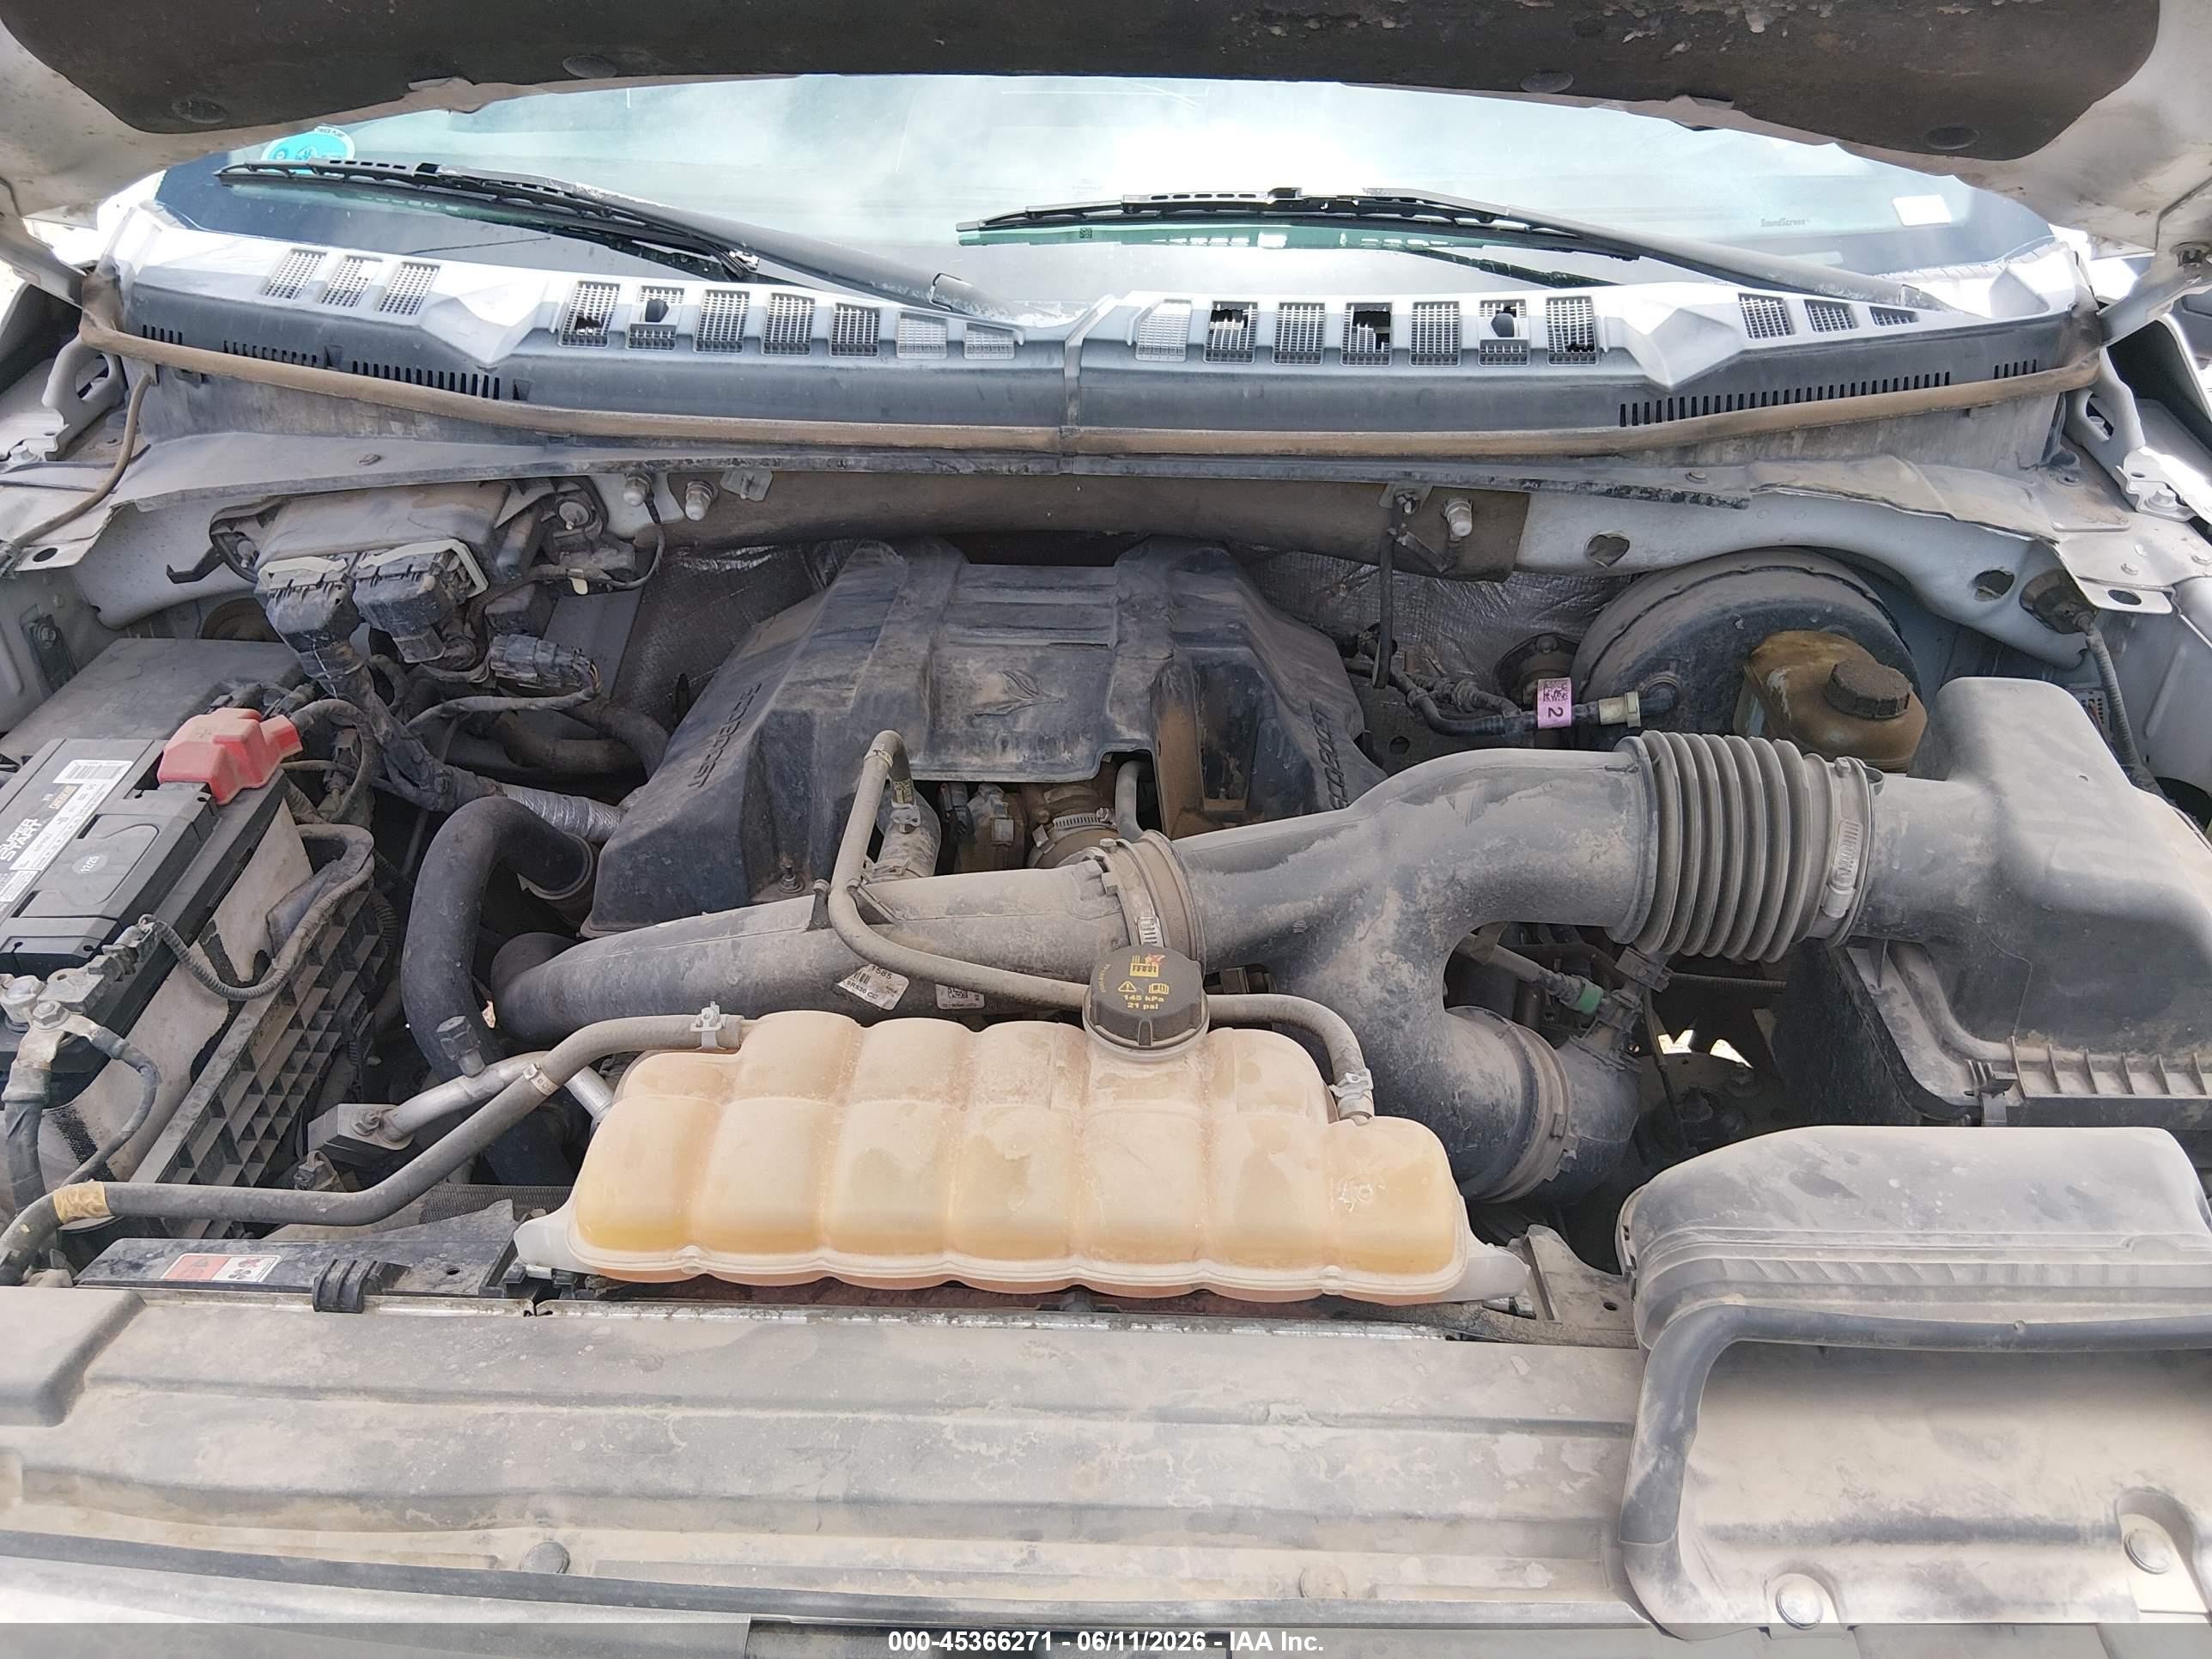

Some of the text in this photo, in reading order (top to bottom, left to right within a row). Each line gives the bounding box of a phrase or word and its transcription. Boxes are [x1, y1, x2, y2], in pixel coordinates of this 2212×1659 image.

[1547, 707, 1564, 718] 2
[0, 822, 42, 862] START
[872, 965, 893, 980] 1585
